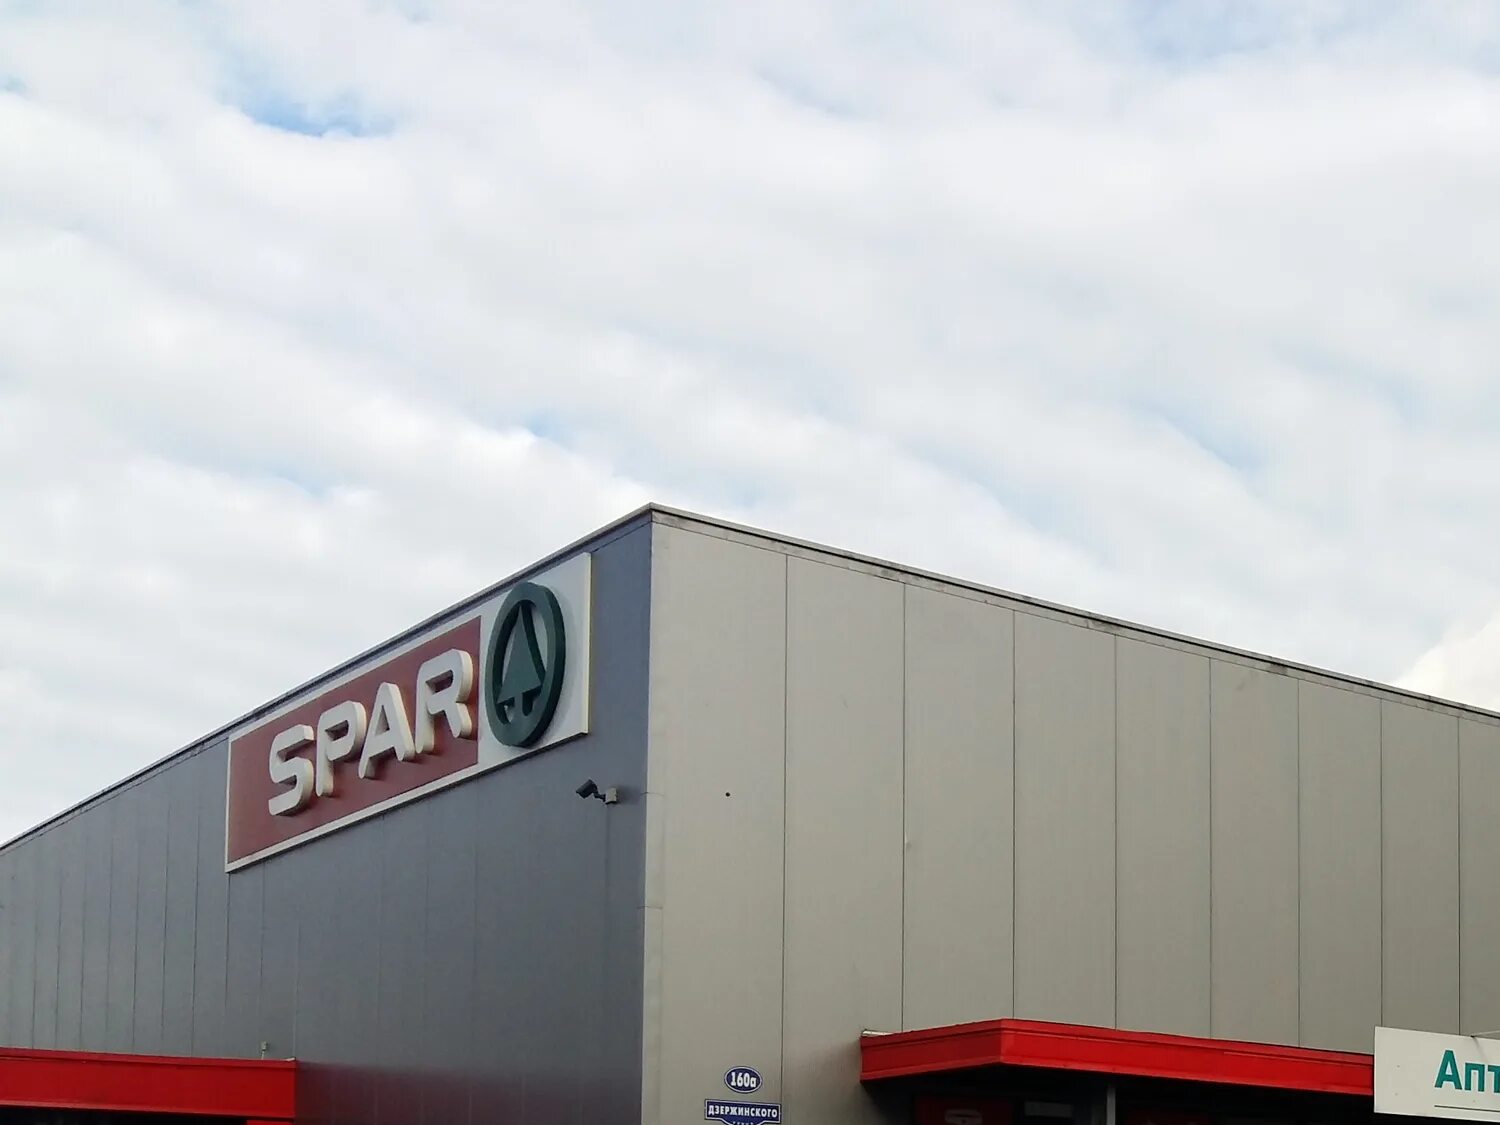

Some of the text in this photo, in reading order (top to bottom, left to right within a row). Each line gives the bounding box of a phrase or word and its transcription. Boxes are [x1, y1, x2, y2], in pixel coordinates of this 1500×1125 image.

[268, 648, 474, 816] SPAR
[730, 1071, 757, 1088] 160а
[708, 1104, 778, 1118] ДЗЕРЖИНСКОГО
